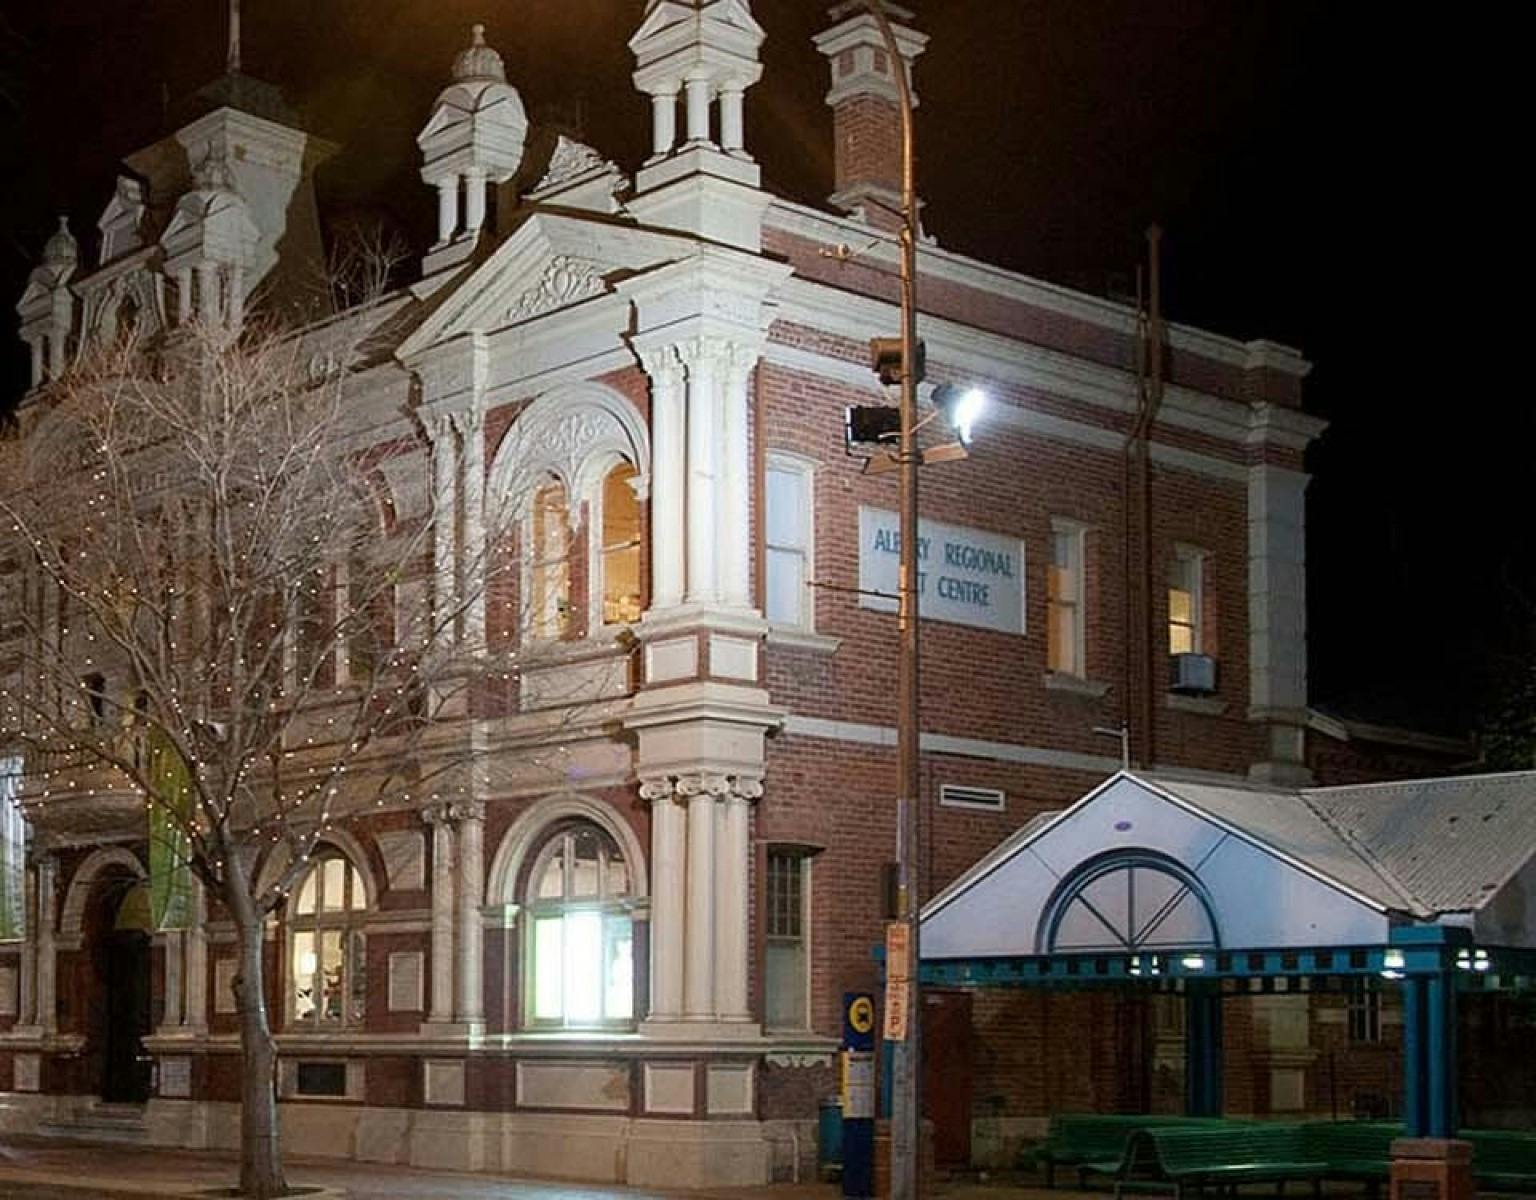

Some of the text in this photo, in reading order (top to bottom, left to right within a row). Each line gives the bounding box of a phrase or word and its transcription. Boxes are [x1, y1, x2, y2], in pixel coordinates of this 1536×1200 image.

[874, 528, 1012, 577] ALBRY REGIONAL
[938, 576, 991, 606] CENTRE
